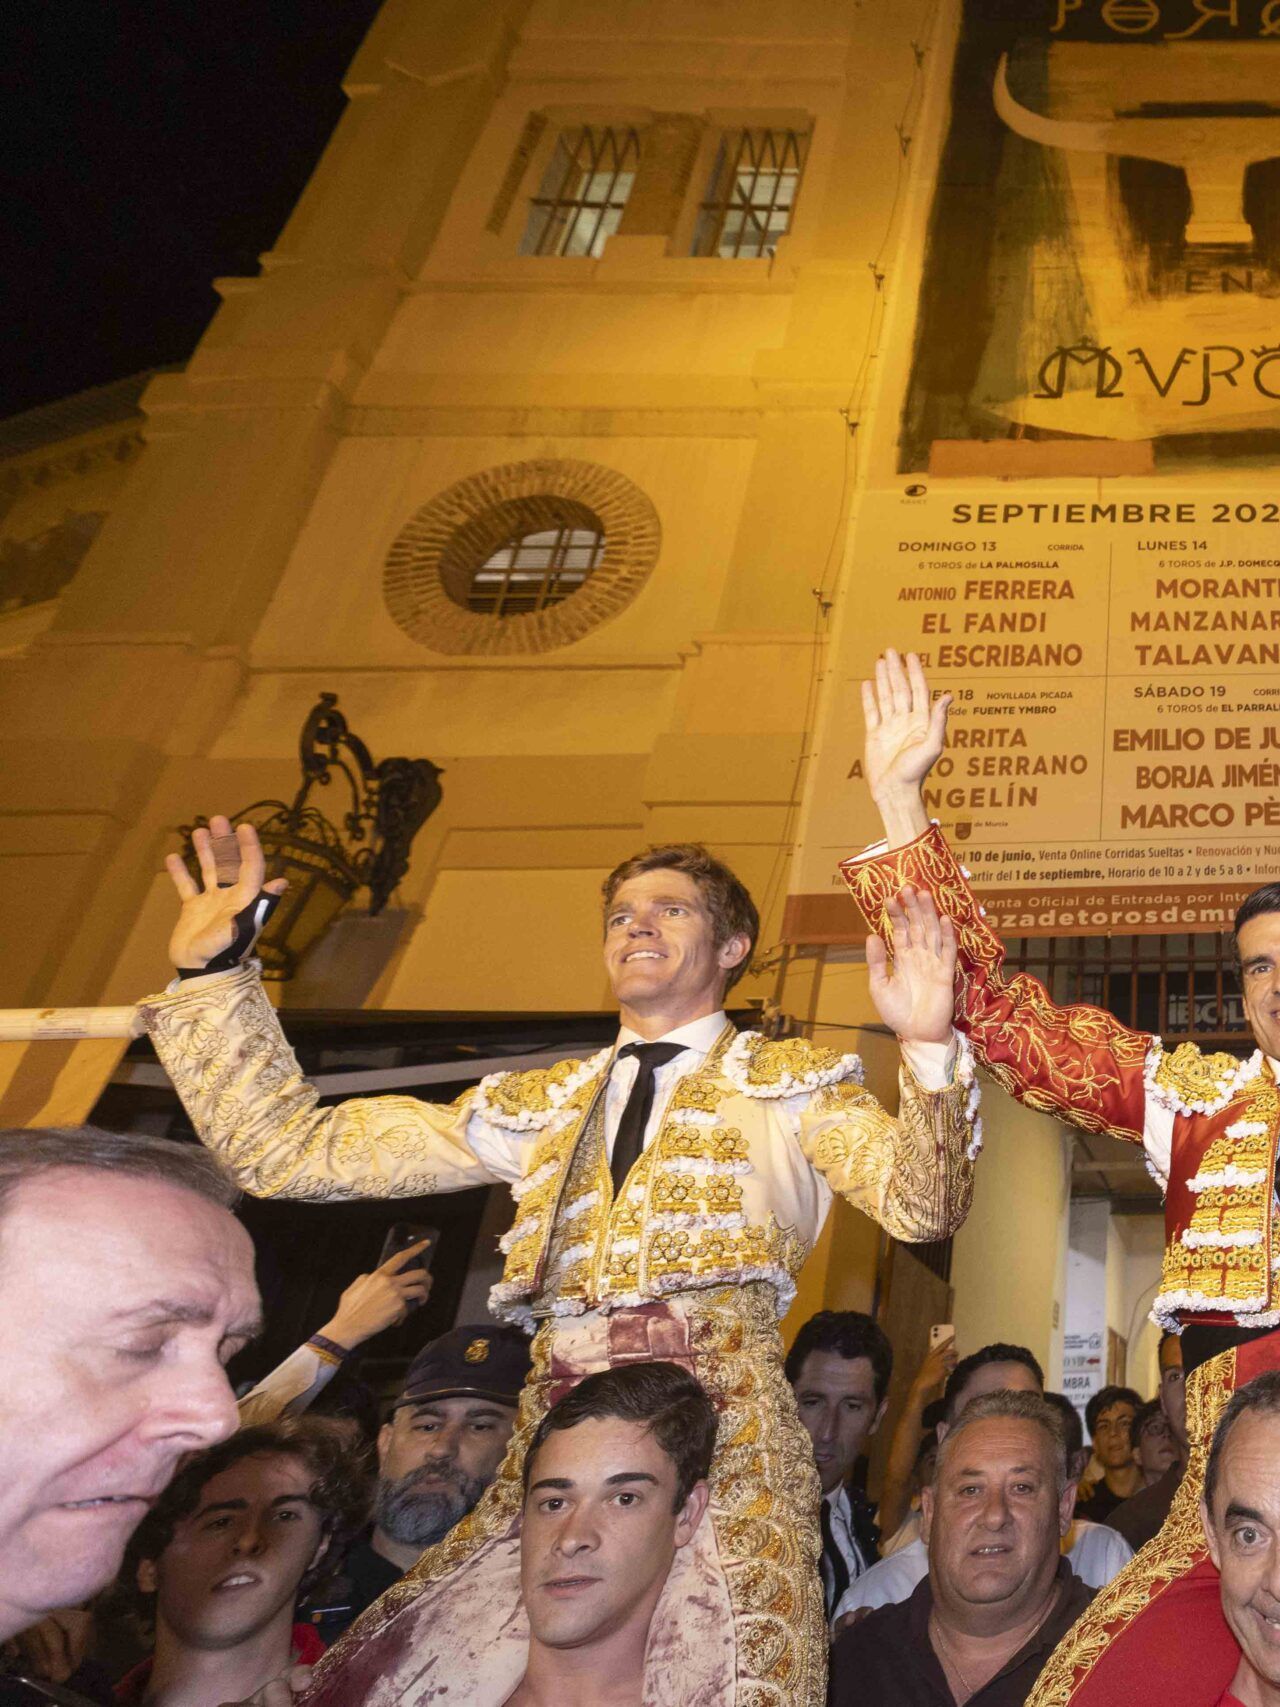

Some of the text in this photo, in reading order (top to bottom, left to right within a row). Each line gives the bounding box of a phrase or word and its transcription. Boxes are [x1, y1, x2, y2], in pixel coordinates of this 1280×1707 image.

[1185, 271, 1253, 293] EN
[952, 503, 1196, 524] SEPTIEMBRE
[898, 541, 997, 552] DOMINGO 13
[1137, 540, 1208, 551] LUNES 14
[918, 562, 925, 570] 6
[928, 562, 962, 570] TOROS
[996, 561, 1059, 569] PALMOSILLA
[1158, 560, 1165, 568] 6
[1167, 560, 1202, 568] TOROS
[1204, 560, 1216, 568] de
[1238, 559, 1280, 568] DOMECQ
[898, 579, 1075, 602] ANTONIO FERRERA
[921, 612, 1046, 634] EL FANDI
[937, 643, 1083, 668] ESCRIBANO
[958, 689, 974, 701] 18
[986, 691, 1073, 700] NOVILLADA PICADA
[1133, 683, 1226, 698] SÁBADO 19
[972, 706, 1015, 715] FUENTE
[1018, 706, 1057, 714] YMBRO
[1157, 704, 1163, 713] 6
[1166, 704, 1203, 713] TOROS
[1206, 704, 1219, 712] de
[1221, 704, 1234, 712] EL
[1112, 728, 1205, 752] EMILIO
[1214, 727, 1251, 750] DE
[966, 754, 1088, 777] SERRANO
[1136, 764, 1214, 790] BORJA
[1120, 803, 1235, 829] MARCO
[969, 851, 982, 862] 10
[985, 850, 999, 861] de
[1000, 849, 1035, 863] junio,
[1039, 850, 1066, 861] Venta
[1070, 848, 1102, 860] Online
[1104, 847, 1146, 859] Corridas
[1148, 846, 1184, 858] Sueltas
[1196, 843, 1252, 857] Renovación
[1255, 847, 1261, 857] y
[996, 870, 1012, 881] del
[1015, 869, 1021, 880] 1
[1023, 869, 1037, 880] de
[1039, 867, 1105, 882] septiembre,
[1108, 866, 1146, 878] Horario
[1148, 866, 1161, 877] de
[1164, 866, 1174, 876] 10
[1177, 868, 1184, 876] a
[1186, 865, 1193, 876] 2
[1195, 868, 1201, 878] y
[1204, 864, 1217, 875] de
[1219, 864, 1225, 875] 5
[1228, 867, 1234, 875] a
[1237, 864, 1243, 875] 8
[977, 897, 1022, 909] Venta
[1028, 895, 1079, 908] Oficial
[1087, 894, 1105, 905] de
[1111, 892, 1181, 905] Entradas
[1187, 893, 1214, 905] por
